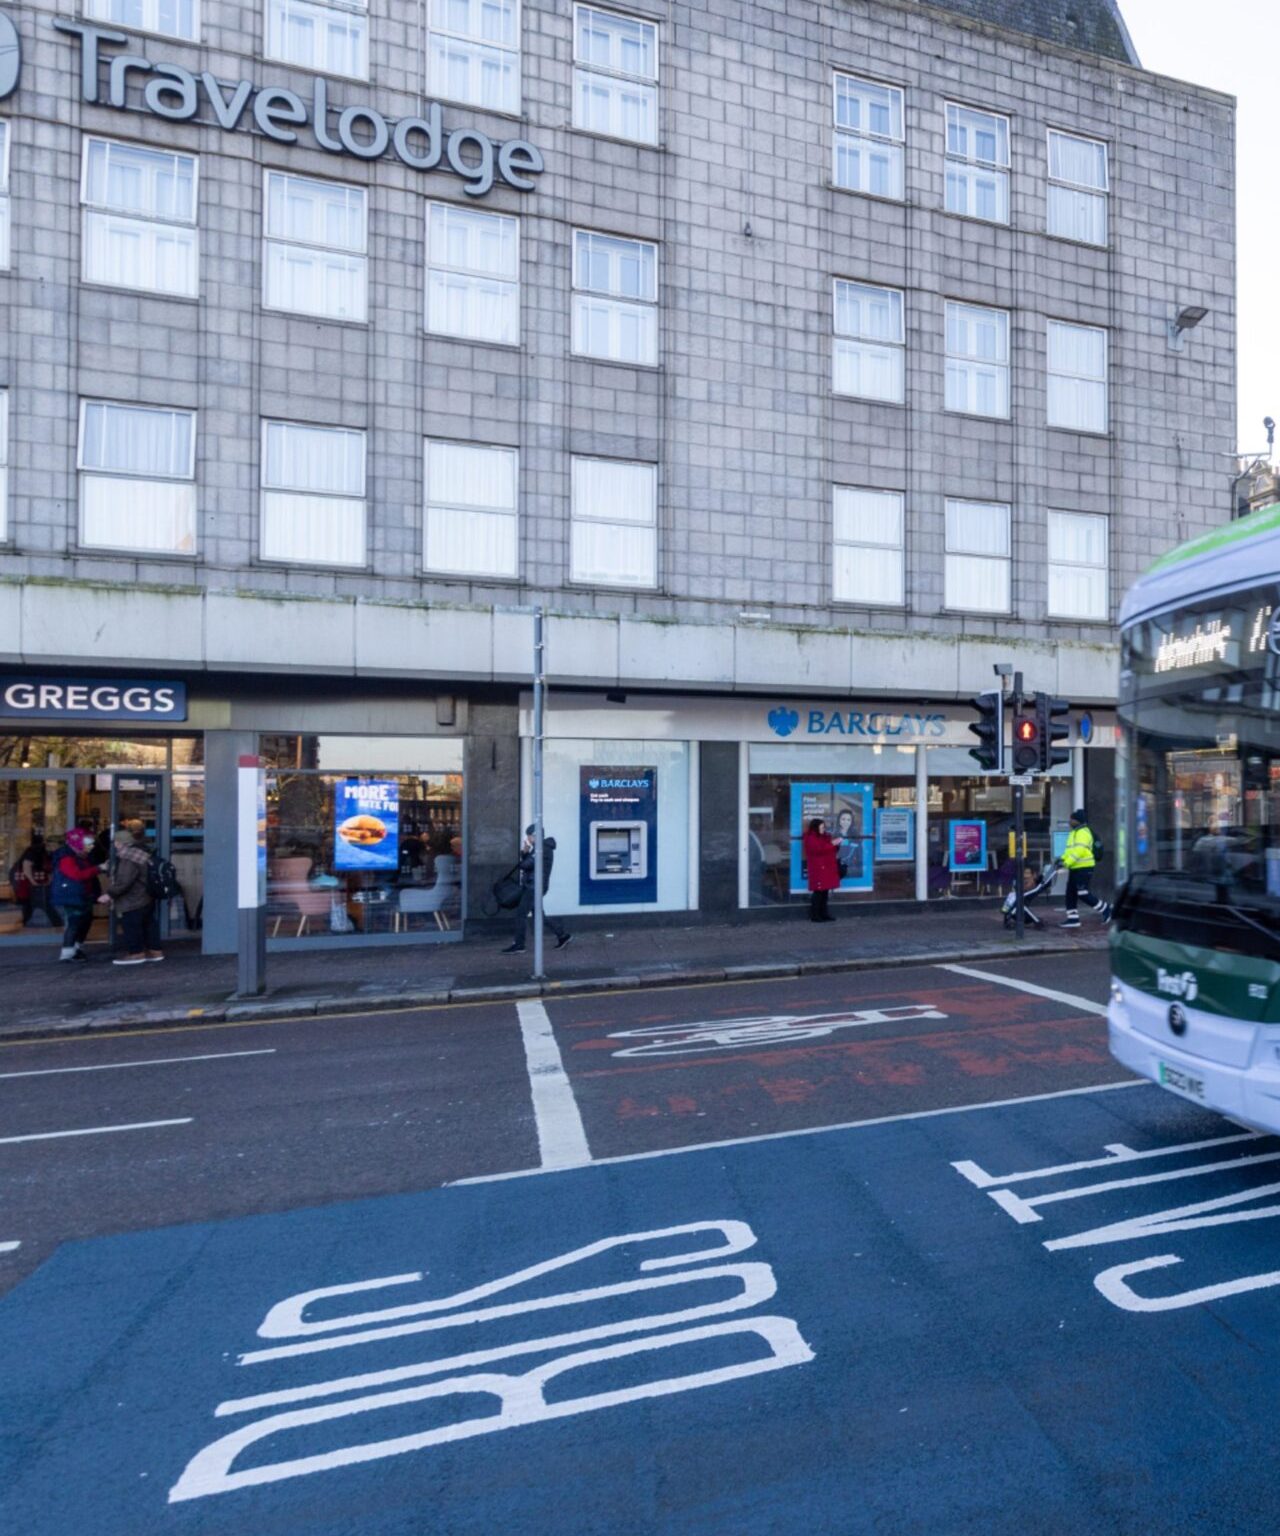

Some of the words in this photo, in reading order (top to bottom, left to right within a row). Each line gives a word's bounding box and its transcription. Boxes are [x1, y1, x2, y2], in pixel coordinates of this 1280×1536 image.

[52, 17, 545, 197] Travelodge
[4, 683, 175, 713] GREGGS
[807, 711, 947, 737] BARCLAYS
[344, 784, 389, 801] MORE
[601, 779, 649, 788] BARCLAYS
[168, 1220, 815, 1503] BUS
